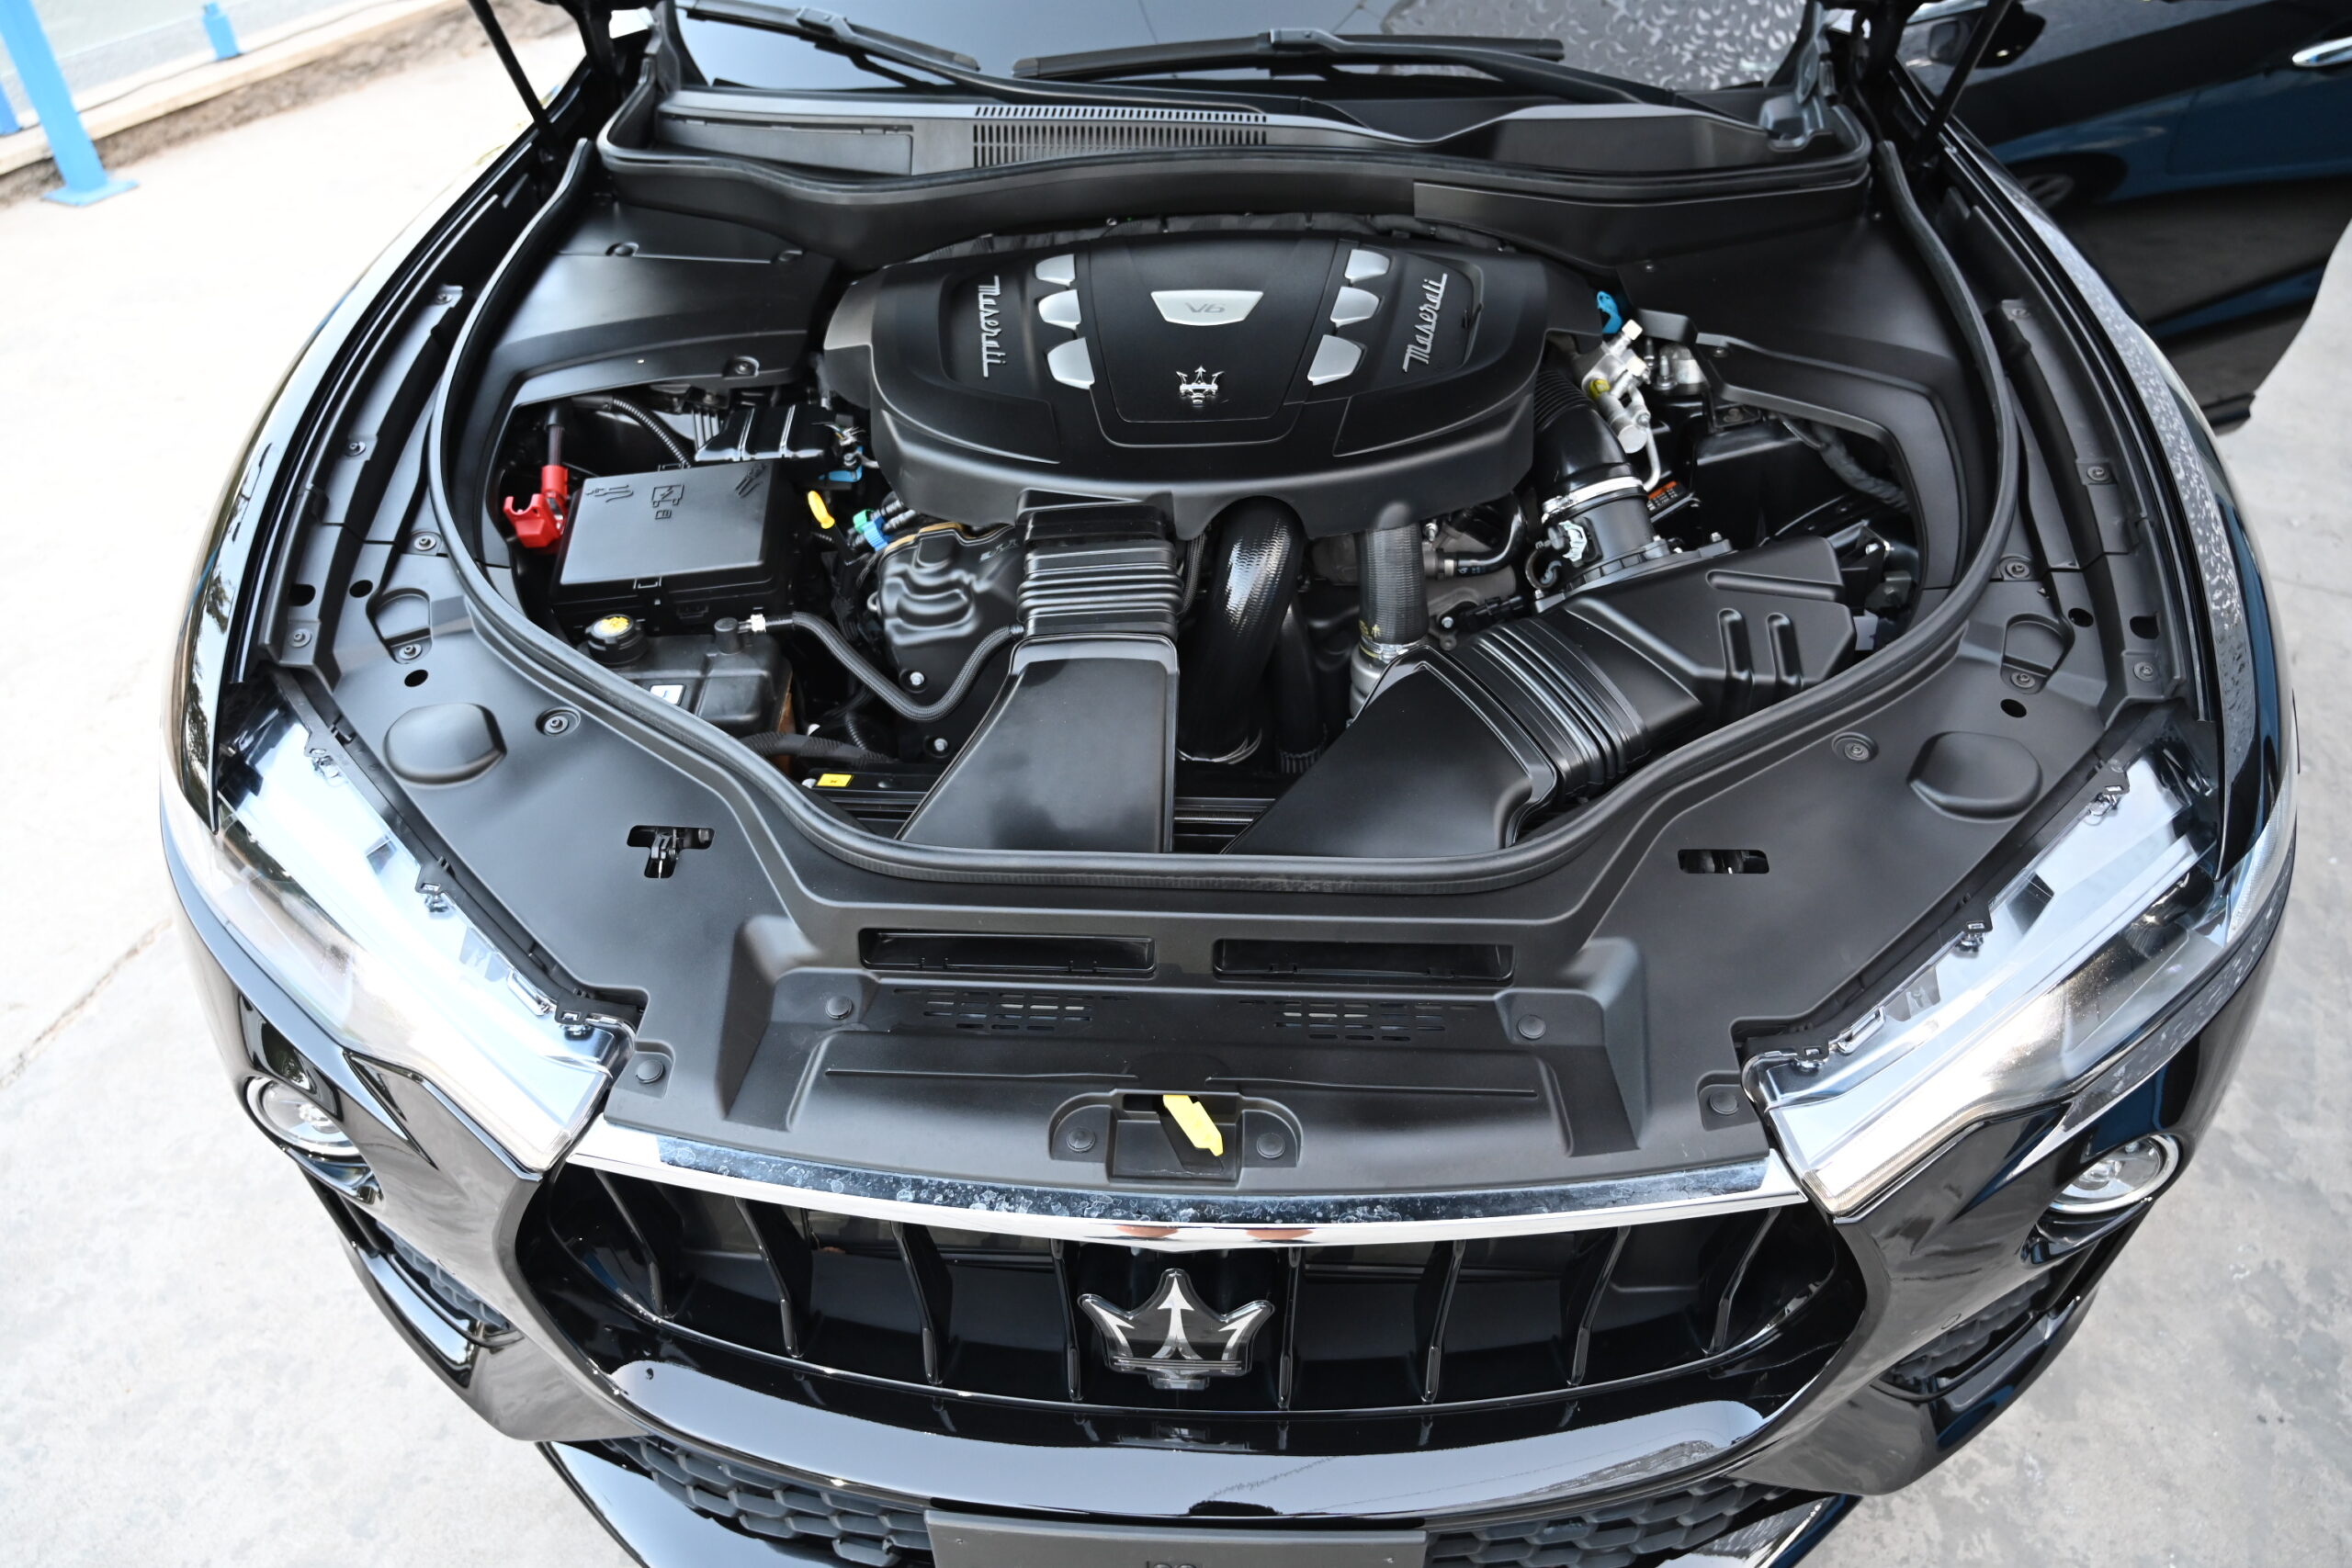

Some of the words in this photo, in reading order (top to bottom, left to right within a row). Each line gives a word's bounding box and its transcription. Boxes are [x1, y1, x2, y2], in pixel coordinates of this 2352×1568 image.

[978, 275, 1007, 378] Maserati
[1184, 301, 1227, 314] V6
[1402, 273, 1448, 372] Maserati
